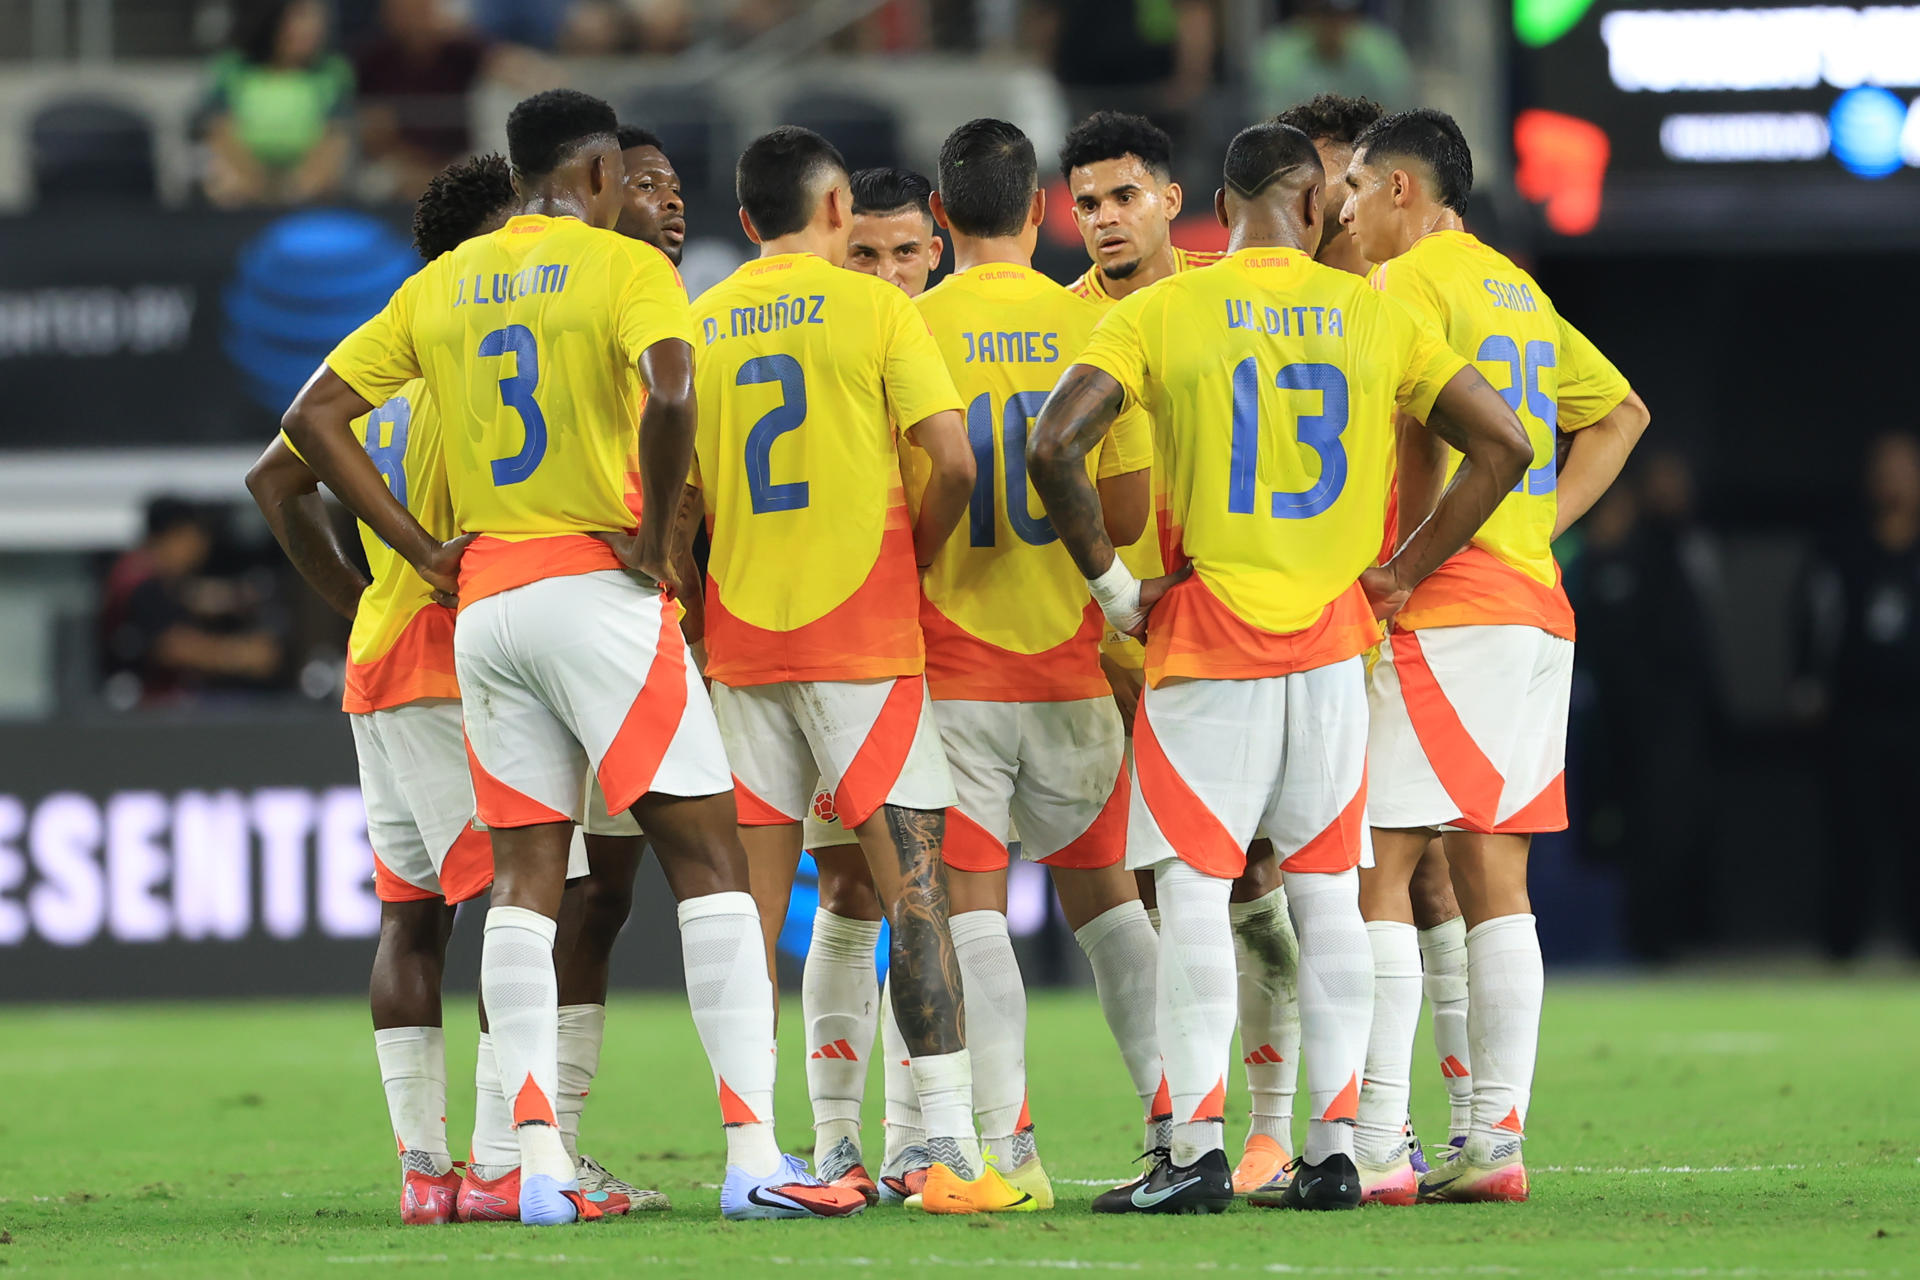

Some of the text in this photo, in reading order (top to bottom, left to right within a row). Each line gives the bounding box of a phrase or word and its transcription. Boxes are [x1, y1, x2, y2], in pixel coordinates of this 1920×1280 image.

[750, 262, 793, 276] COLOMBIA
[978, 271, 1026, 281] COLOMBIA
[1244, 257, 1290, 269] COLOMBIA
[703, 293, 825, 346] D.MUÑOZ
[1225, 299, 1343, 337] W.DITTA
[962, 331, 1059, 363] JAMES
[478, 324, 548, 487] 3
[736, 353, 809, 514] 2
[1228, 356, 1349, 520] 13
[967, 390, 1061, 548] 10
